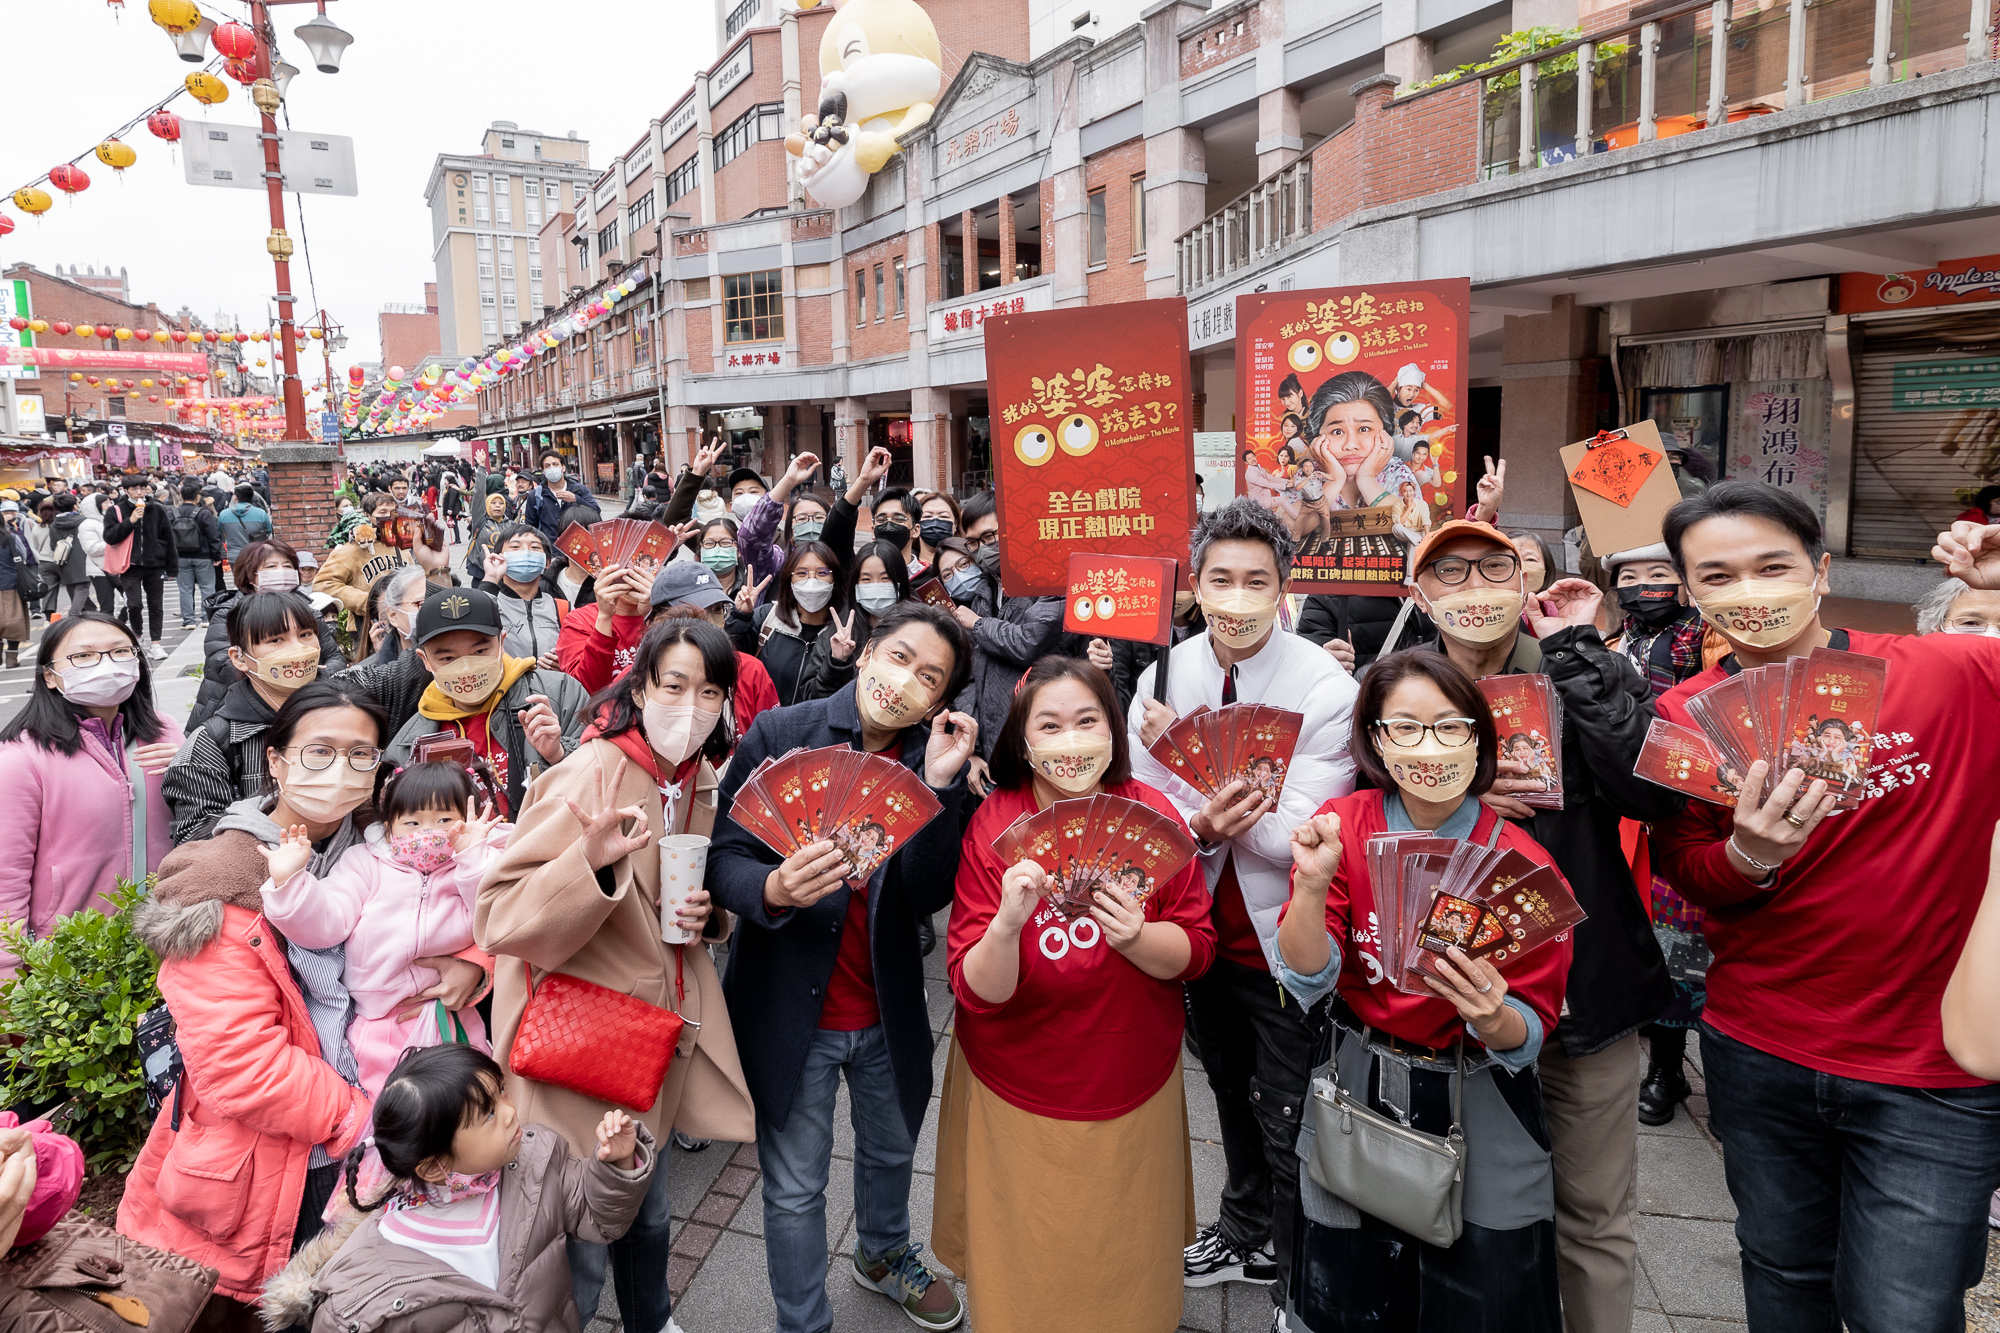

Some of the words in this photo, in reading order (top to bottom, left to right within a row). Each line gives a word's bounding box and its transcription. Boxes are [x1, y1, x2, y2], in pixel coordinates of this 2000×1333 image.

[946, 108, 1020, 165] 永樂市場
[727, 350, 781, 369] 永樂市場
[1001, 363, 1172, 425] 我的婆婆怎麼把
[1100, 401, 1178, 434] 搞丟了?
[1110, 433, 1146, 447] Motherbaker
[1150, 429, 1162, 438] The
[1162, 425, 1180, 436] Movie
[1760, 397, 1802, 496] 翔鴻布
[162, 454, 180, 466] 88
[1048, 487, 1142, 514] 全台戲院
[1038, 516, 1155, 541] 現正熱映中
[1317, 568, 1403, 582] 口碑爆棚熱映中
[1865, 764, 1885, 774] baker
[1888, 758, 1903, 766] The
[1901, 752, 1920, 761] Movie
